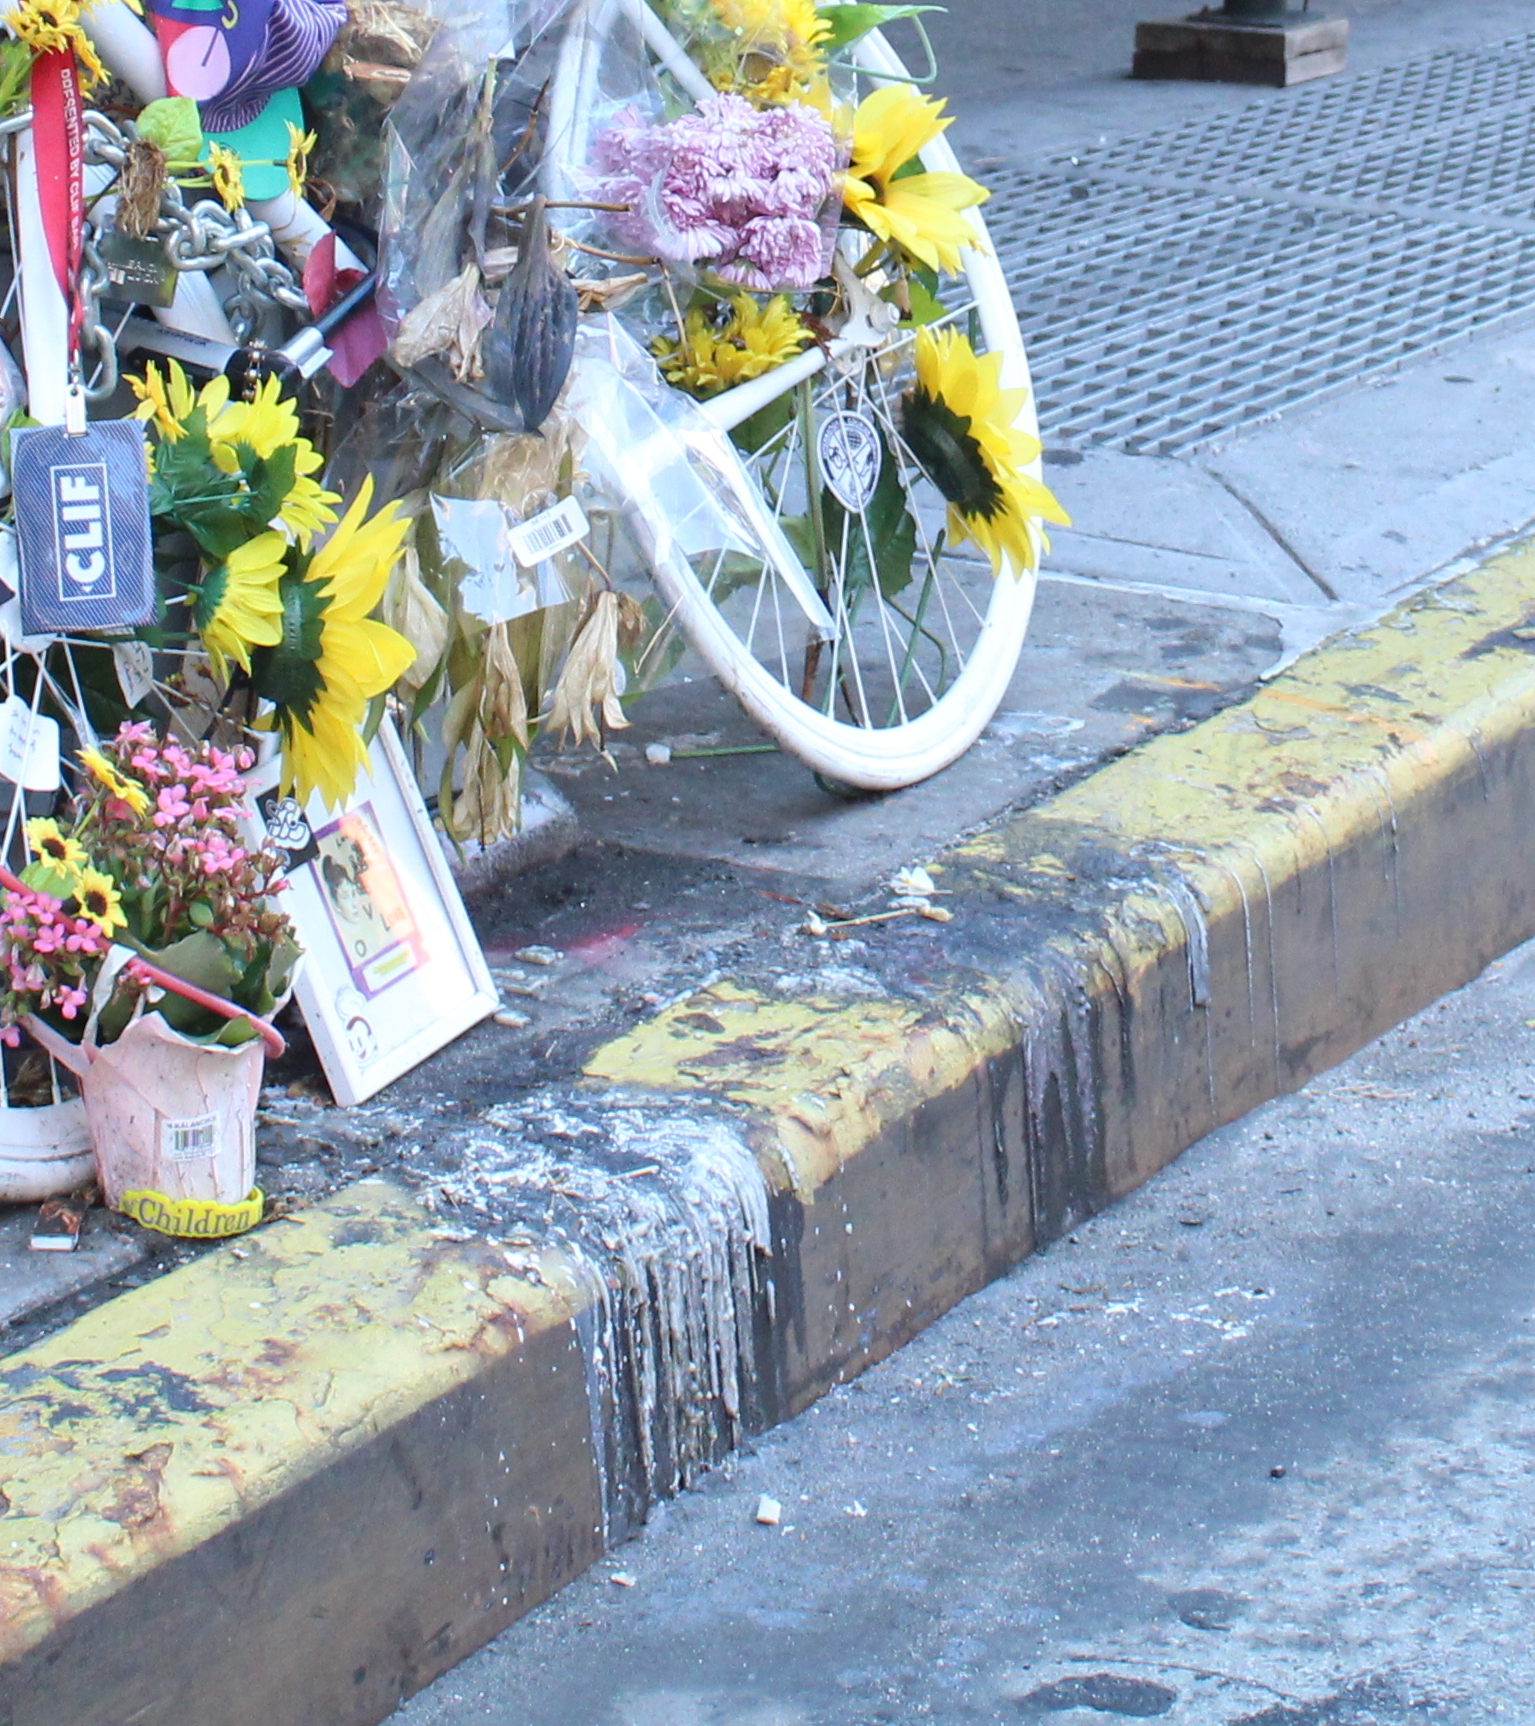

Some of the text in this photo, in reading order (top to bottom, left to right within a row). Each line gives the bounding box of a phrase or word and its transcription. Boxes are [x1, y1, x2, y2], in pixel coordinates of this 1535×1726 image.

[69, 161, 80, 179] BY
[69, 182, 80, 214] CLIF
[59, 476, 106, 584] CLIF
[138, 1197, 251, 1236] Children
